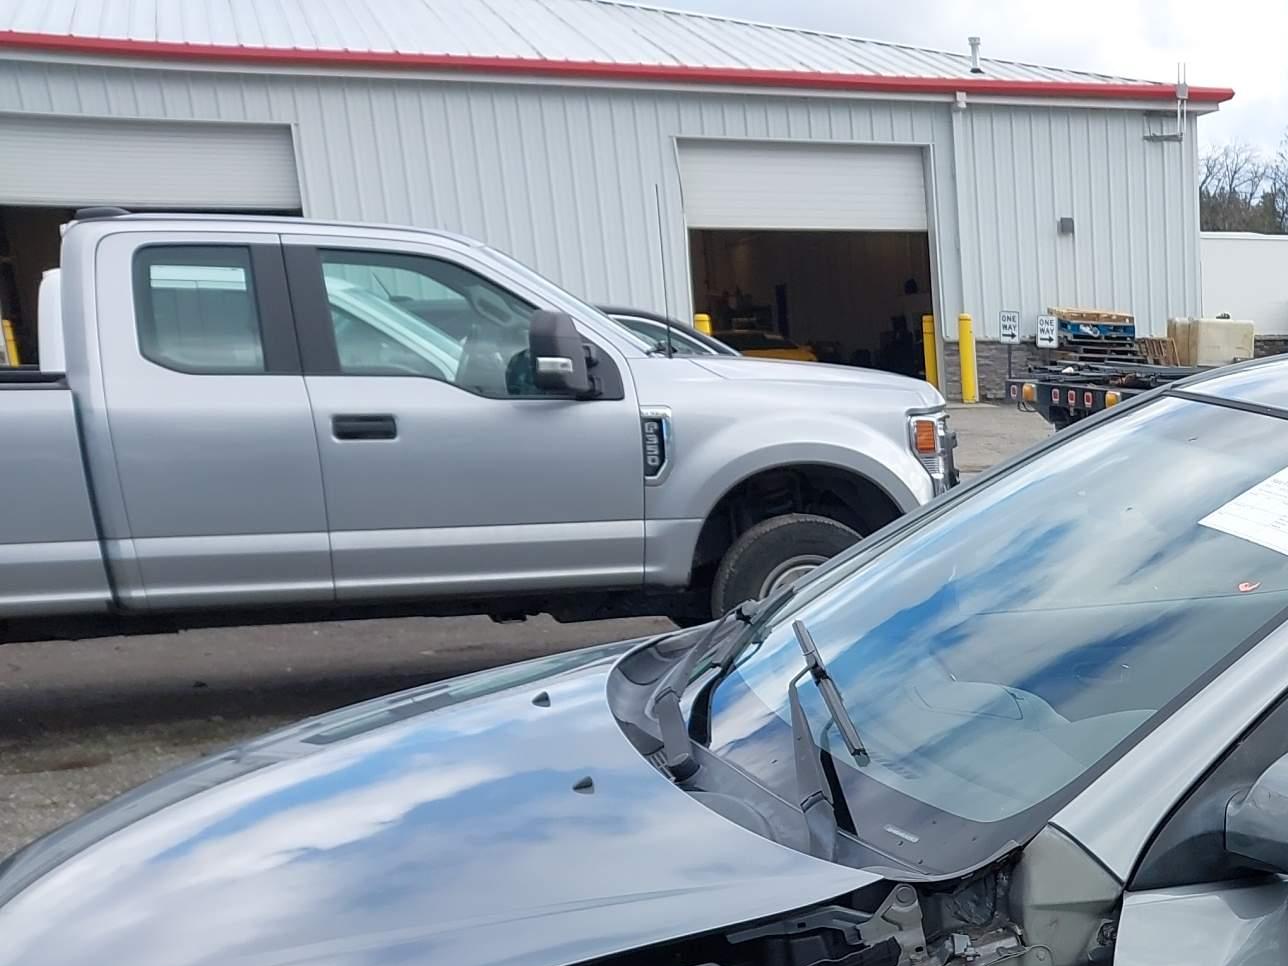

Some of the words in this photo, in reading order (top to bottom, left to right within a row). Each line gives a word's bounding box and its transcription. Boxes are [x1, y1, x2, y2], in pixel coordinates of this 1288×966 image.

[1001, 314, 1017, 322] ONE
[1039, 318, 1055, 327] ONE
[1002, 323, 1017, 331] WAY
[1040, 327, 1055, 335] WAY
